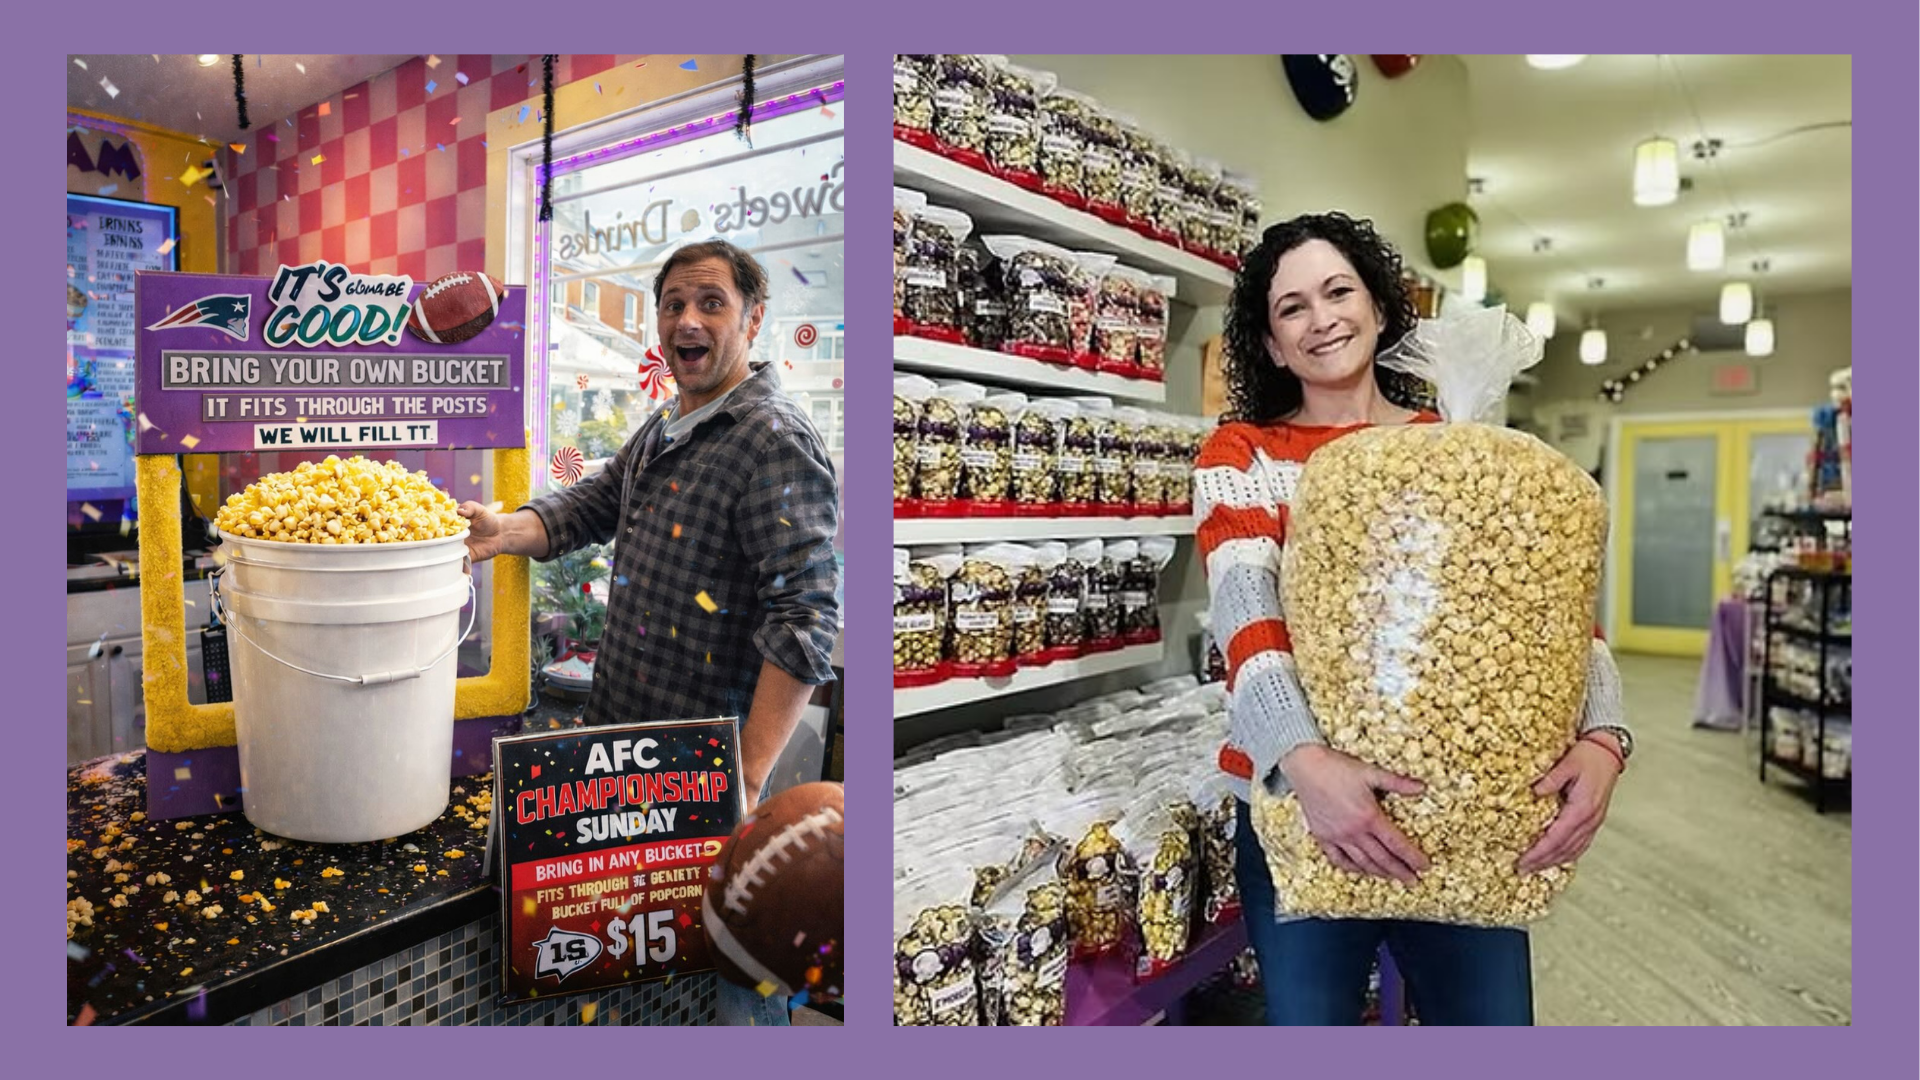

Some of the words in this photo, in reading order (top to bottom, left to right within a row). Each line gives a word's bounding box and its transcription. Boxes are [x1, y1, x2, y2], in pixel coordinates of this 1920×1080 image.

[271, 263, 347, 302] IT'S
[267, 303, 410, 344] GOOD!
[170, 356, 260, 384] BRING
[270, 357, 340, 384] YOUR
[350, 358, 405, 384] OWN
[412, 359, 503, 384] BUCKET
[207, 398, 229, 417] IT
[240, 397, 287, 417] FITS
[295, 396, 384, 416] THROUGH
[392, 396, 427, 414] THE
[432, 396, 487, 414] POSTS
[259, 427, 293, 444] WE
[300, 426, 352, 443] WILL
[359, 425, 402, 442] FILL
[584, 738, 661, 775] AFC
[516, 771, 728, 825] CHAMPIONSHIP
[576, 807, 678, 844] SUNDAY
[536, 859, 583, 882] BRING
[589, 856, 604, 872] IN
[608, 850, 640, 871] ANY
[645, 842, 702, 864] BUCKET
[536, 887, 564, 904] FITS
[568, 876, 629, 898] THROUGH
[552, 901, 597, 920] BUCKET
[601, 896, 625, 914] FULL
[631, 892, 645, 907] OF
[650, 884, 702, 903] POPCORN
[606, 908, 677, 967] $15
